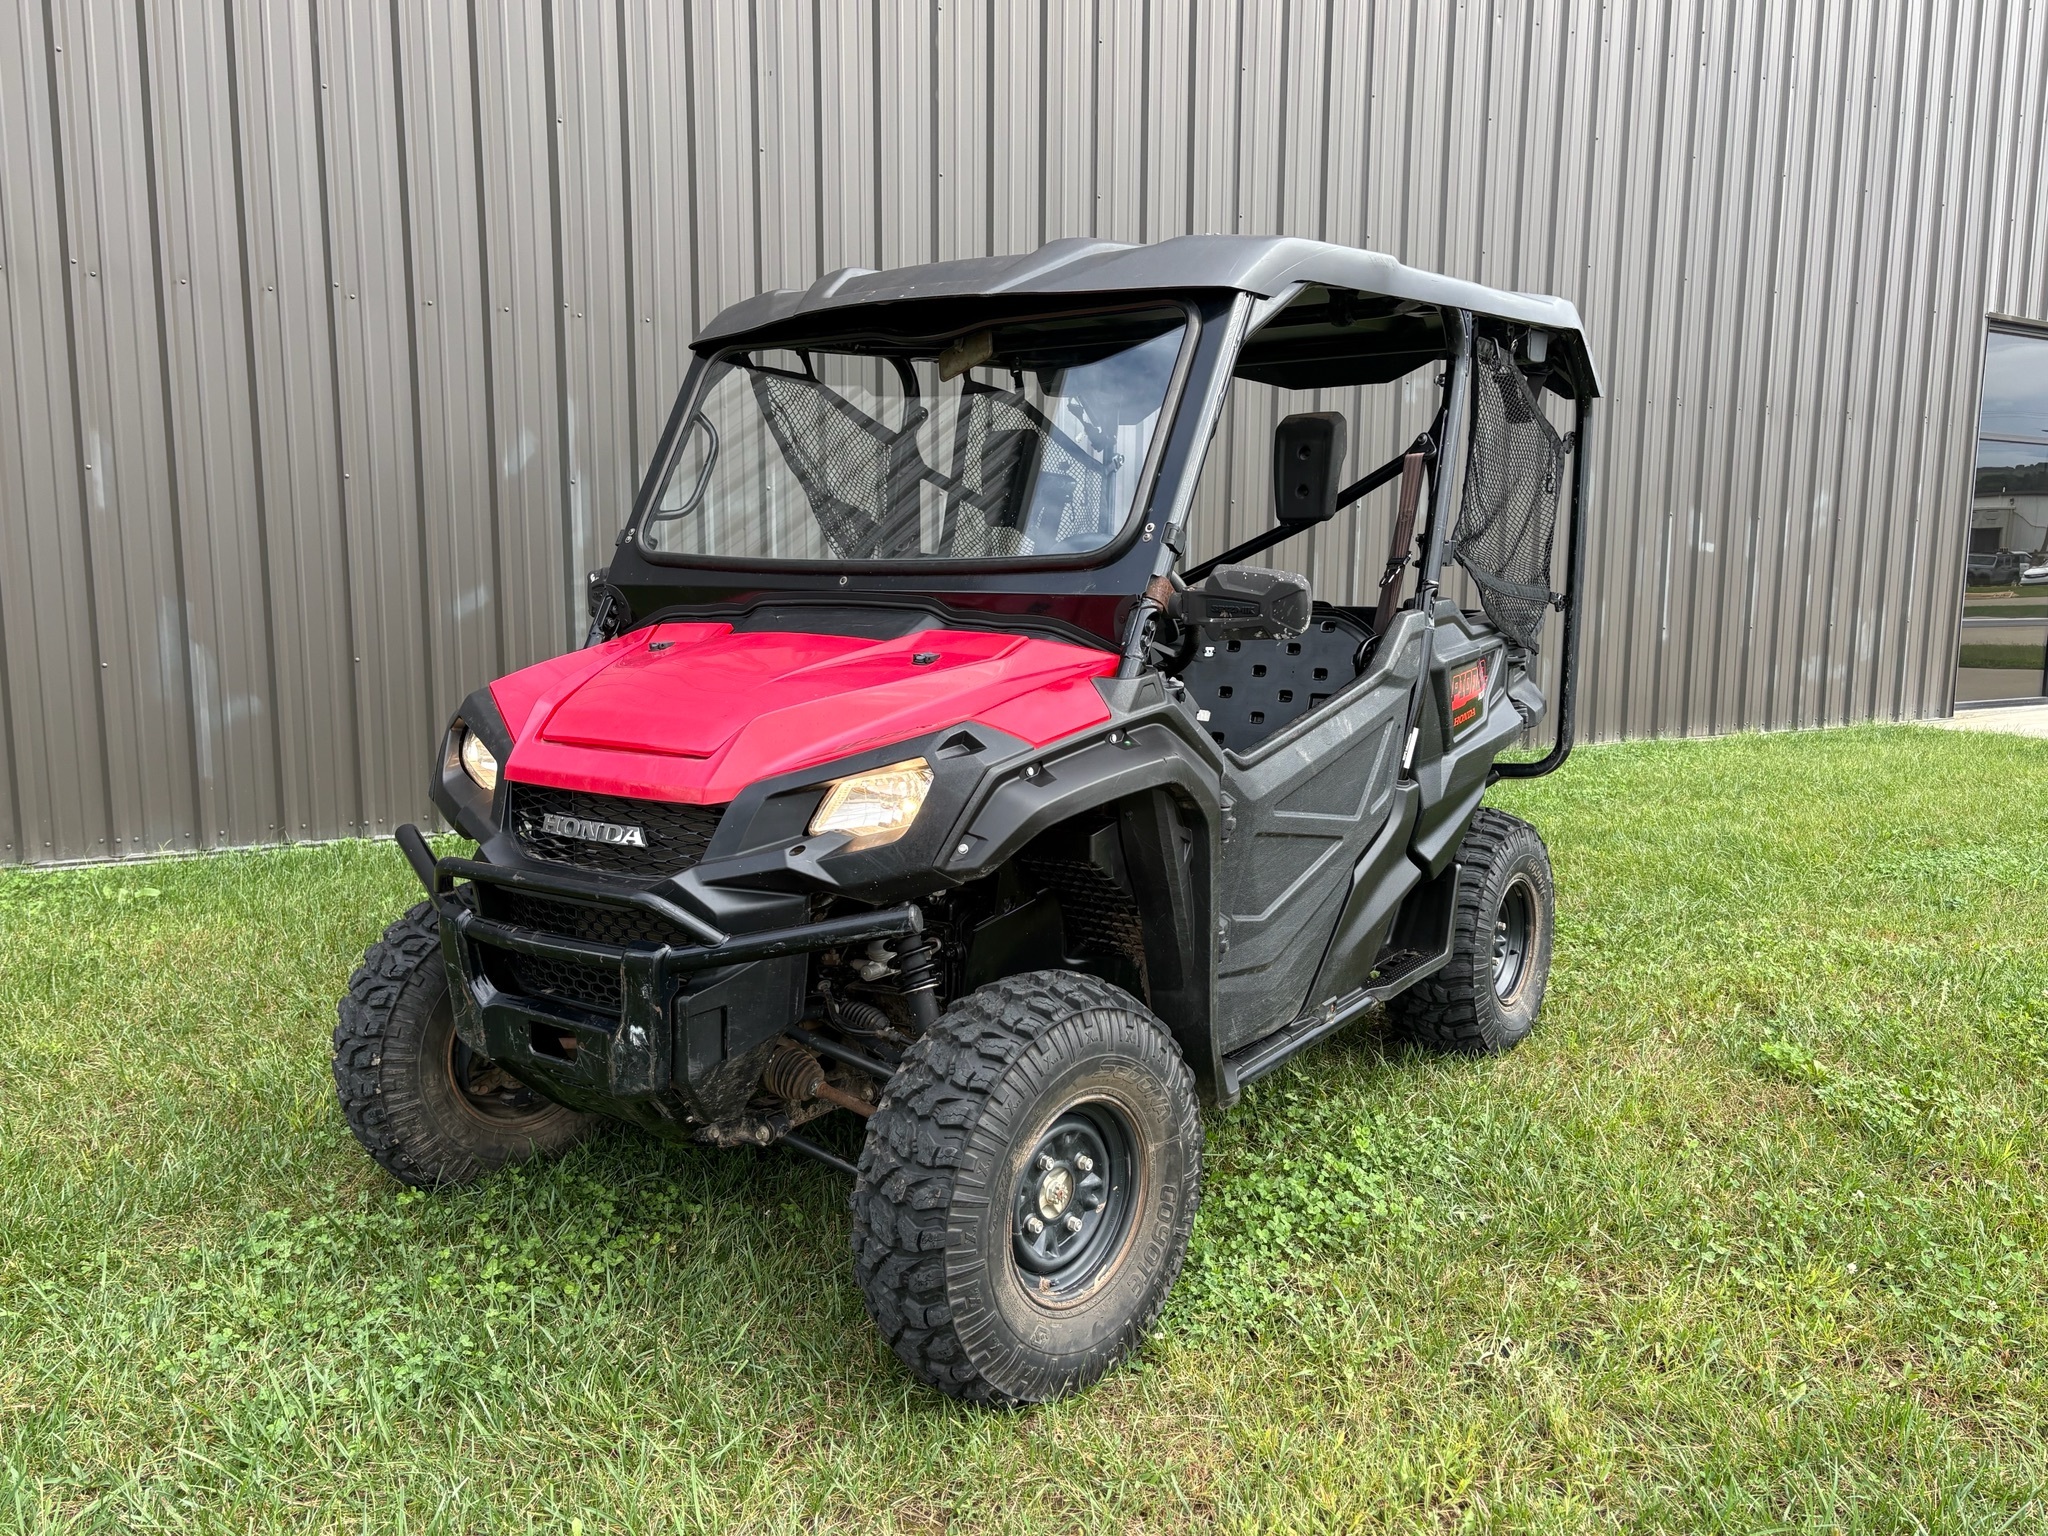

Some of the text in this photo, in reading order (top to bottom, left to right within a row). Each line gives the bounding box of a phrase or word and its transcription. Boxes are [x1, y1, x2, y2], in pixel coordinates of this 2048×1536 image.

[541, 813, 648, 847] HONDA
[1091, 1058, 1172, 1124] SEDONA
[1126, 1184, 1178, 1299] COYOTE
